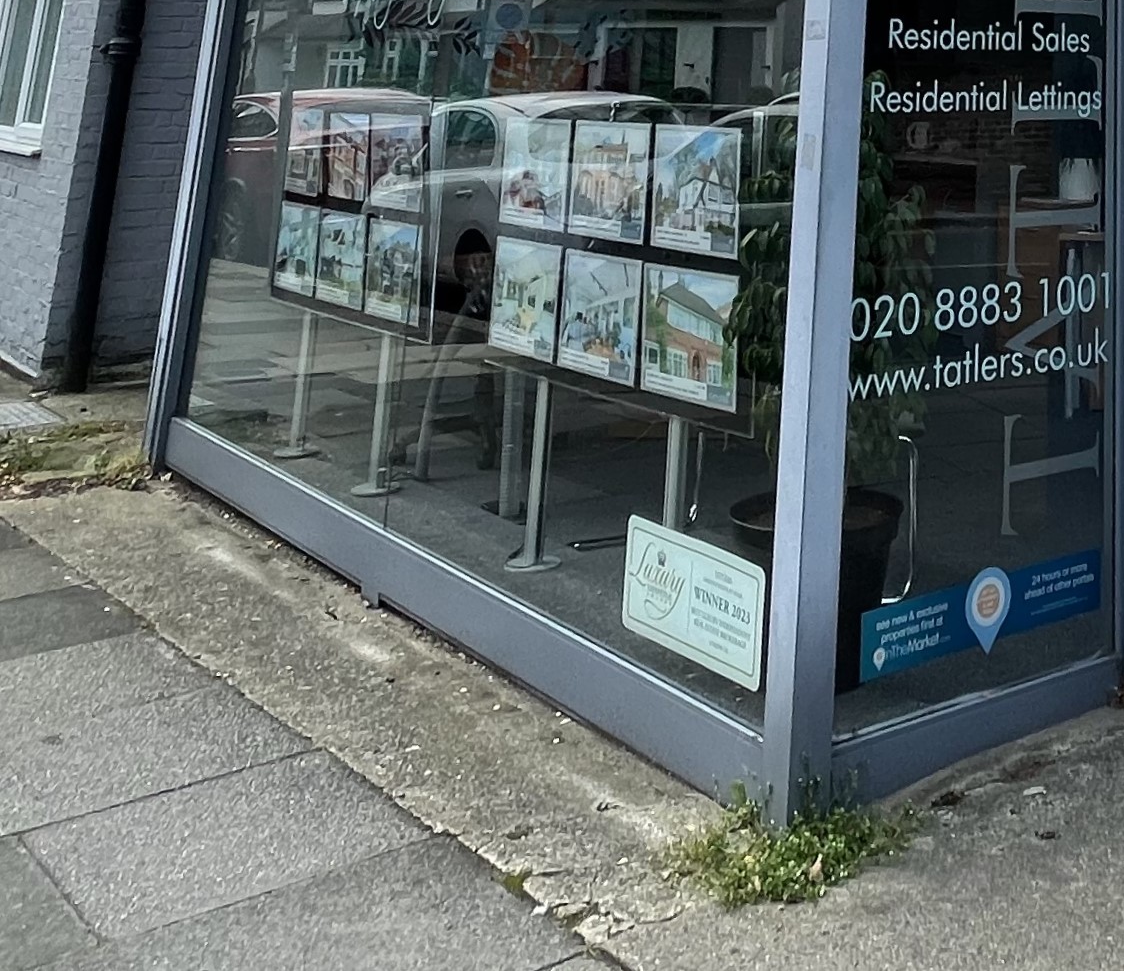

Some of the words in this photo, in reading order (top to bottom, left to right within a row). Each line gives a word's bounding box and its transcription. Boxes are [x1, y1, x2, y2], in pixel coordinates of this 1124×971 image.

[887, 18, 1023, 52] Residential
[1031, 22, 1091, 54] Sales
[869, 79, 1009, 113] Residential
[1017, 81, 1102, 118] Lettings
[849, 292, 921, 341] 020
[934, 280, 1023, 331] 8883
[1038, 271, 1112, 317] 1001
[847, 326, 1109, 403] www.tatlers.co.uk
[693, 585, 730, 615] WINNER
[731, 604, 751, 626] 2023
